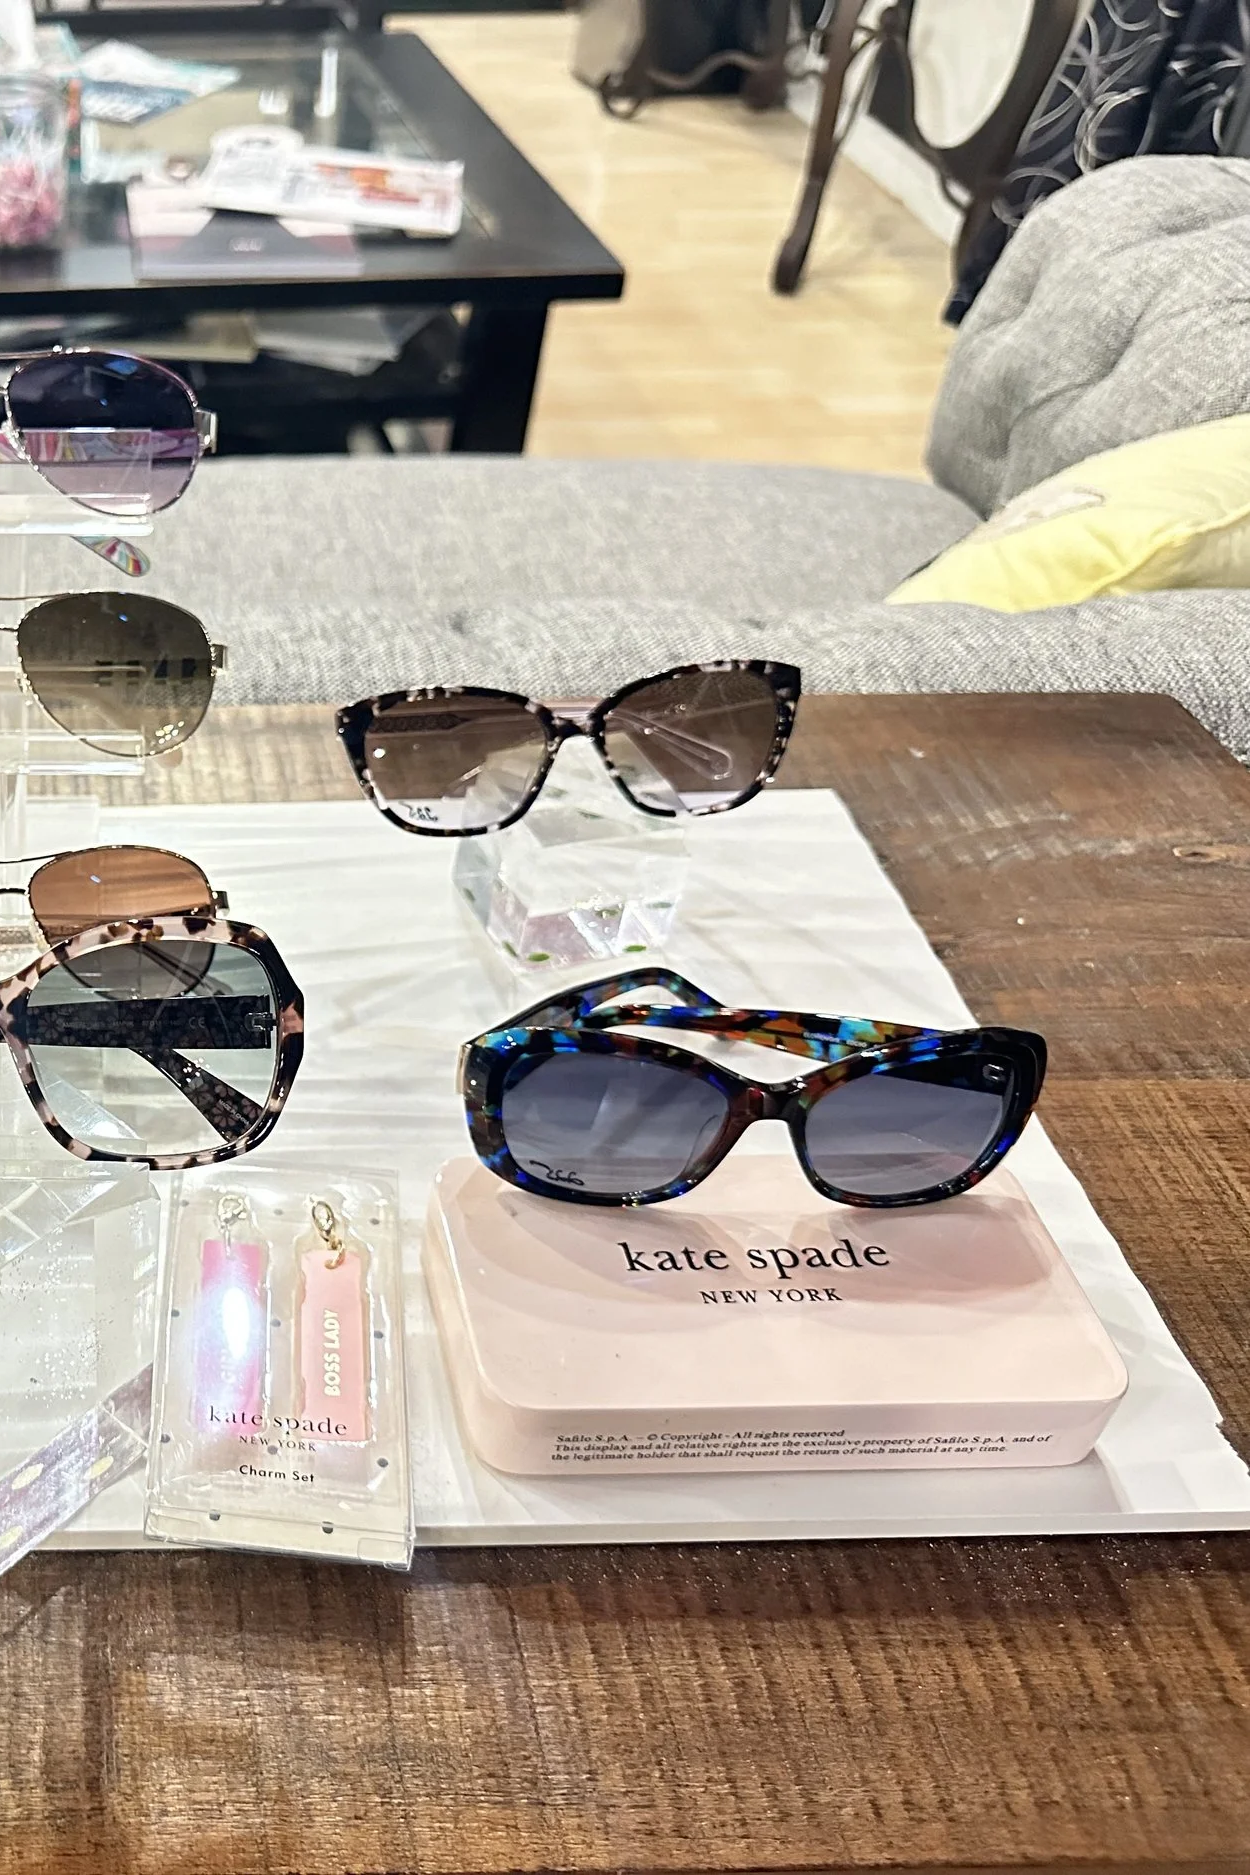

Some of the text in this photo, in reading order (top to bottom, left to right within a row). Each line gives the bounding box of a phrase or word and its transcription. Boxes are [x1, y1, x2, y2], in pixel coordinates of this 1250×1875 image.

[617, 1239, 890, 1280] kate spade
[699, 1288, 843, 1304] NEW YORK
[322, 1309, 341, 1397] BOSS LADY
[210, 1405, 347, 1436] kate spade
[239, 1435, 317, 1452] NEW YORK
[556, 1434, 591, 1442] Safilo
[660, 1432, 722, 1443] Copyright
[754, 1431, 789, 1440] rights
[792, 1430, 845, 1438] reserved
[583, 1443, 626, 1454] display
[655, 1442, 670, 1450] all
[673, 1441, 720, 1449] relative
[722, 1440, 758, 1449] rights
[803, 1439, 861, 1447] exclusive
[862, 1437, 915, 1447] property
[917, 1436, 934, 1444] of
[934, 1436, 969, 1444] Safilo
[1012, 1435, 1035, 1443] and
[1037, 1434, 1053, 1442] of
[551, 1453, 570, 1461] the
[573, 1452, 634, 1462] legitimate
[637, 1451, 675, 1459] holder
[704, 1450, 733, 1458] shall
[736, 1449, 780, 1458] request
[842, 1447, 858, 1455] of
[859, 1447, 885, 1455] such
[888, 1446, 938, 1454] material
[954, 1446, 977, 1455] any
[239, 1464, 314, 1482] Charm Set
